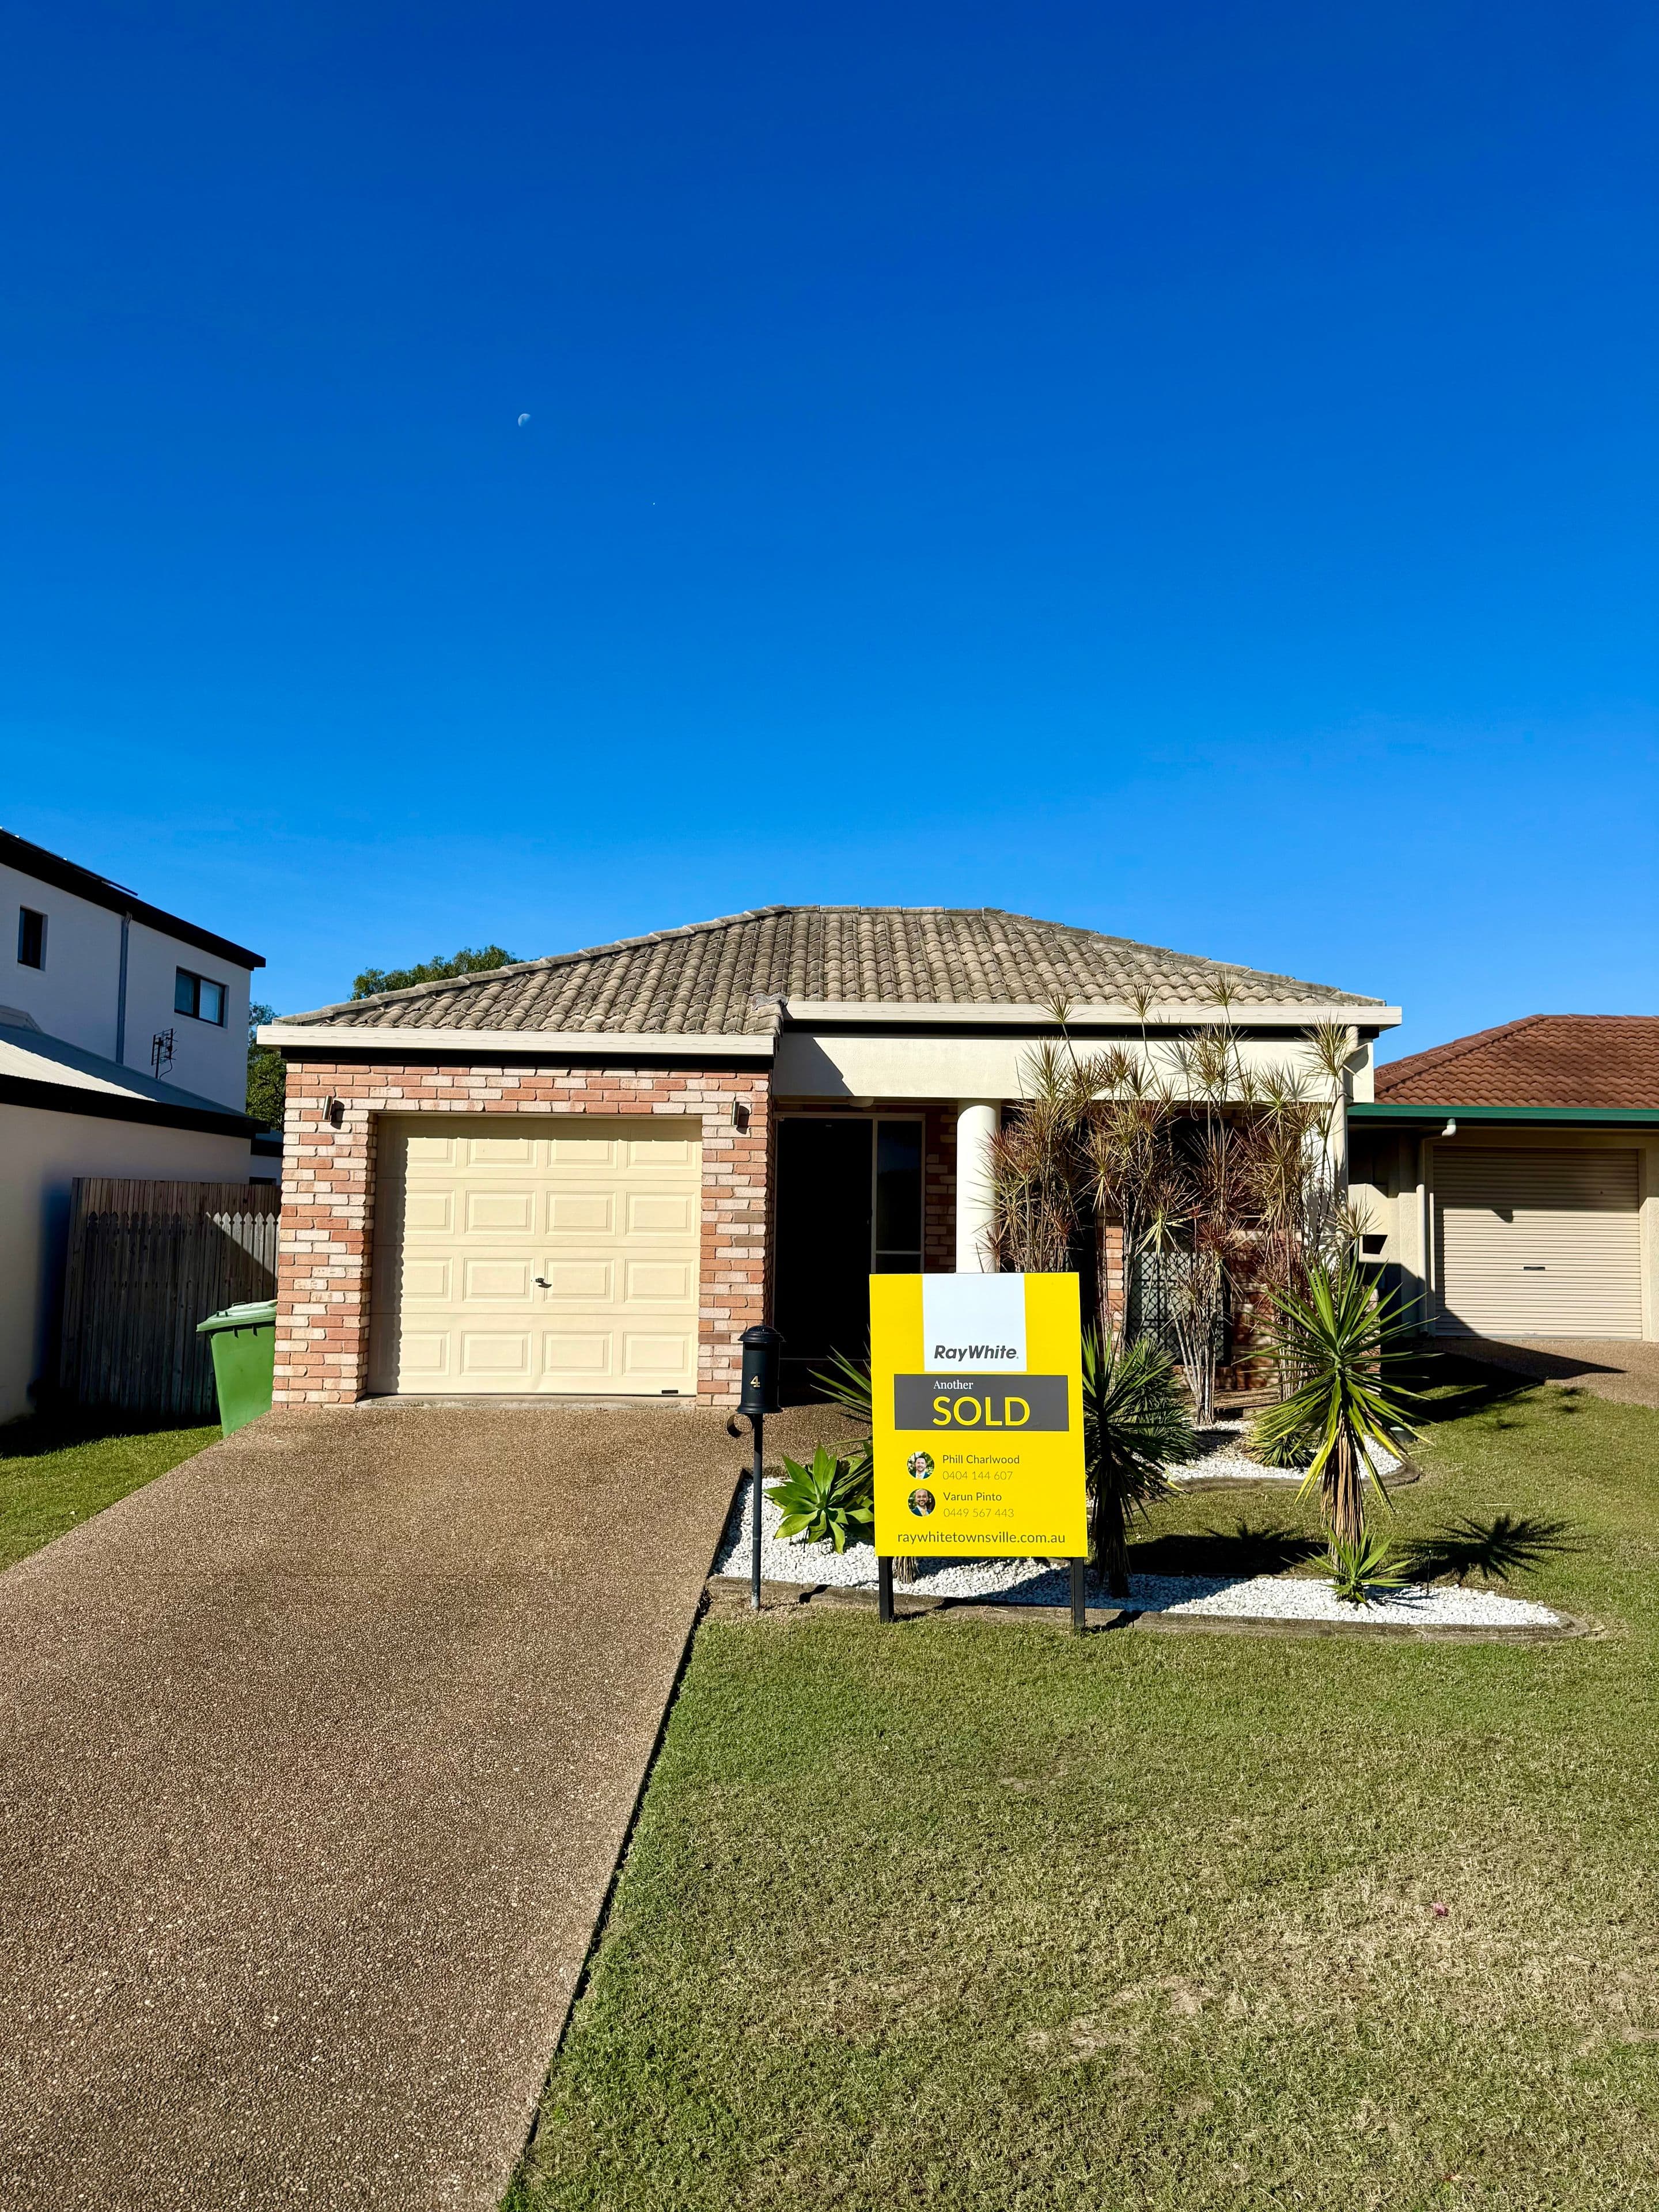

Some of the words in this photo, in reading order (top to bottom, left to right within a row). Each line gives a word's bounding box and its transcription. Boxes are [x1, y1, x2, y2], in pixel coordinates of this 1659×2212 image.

[750, 1376, 760, 1388] 4
[933, 1380, 974, 1389] Another
[933, 1396, 1030, 1426] SOLD
[942, 1455, 963, 1464] Phill
[966, 1455, 1020, 1464] Charlwood
[942, 1471, 968, 1480] 0404
[972, 1471, 991, 1480] 144
[994, 1471, 1013, 1480] 607
[943, 1492, 973, 1501] Varun
[976, 1492, 1002, 1501] Pinto
[944, 1508, 969, 1517] 0449
[972, 1508, 991, 1517] 567
[994, 1508, 1014, 1518] 443
[897, 1531, 1065, 1544] raywhitetownsville.com.au
